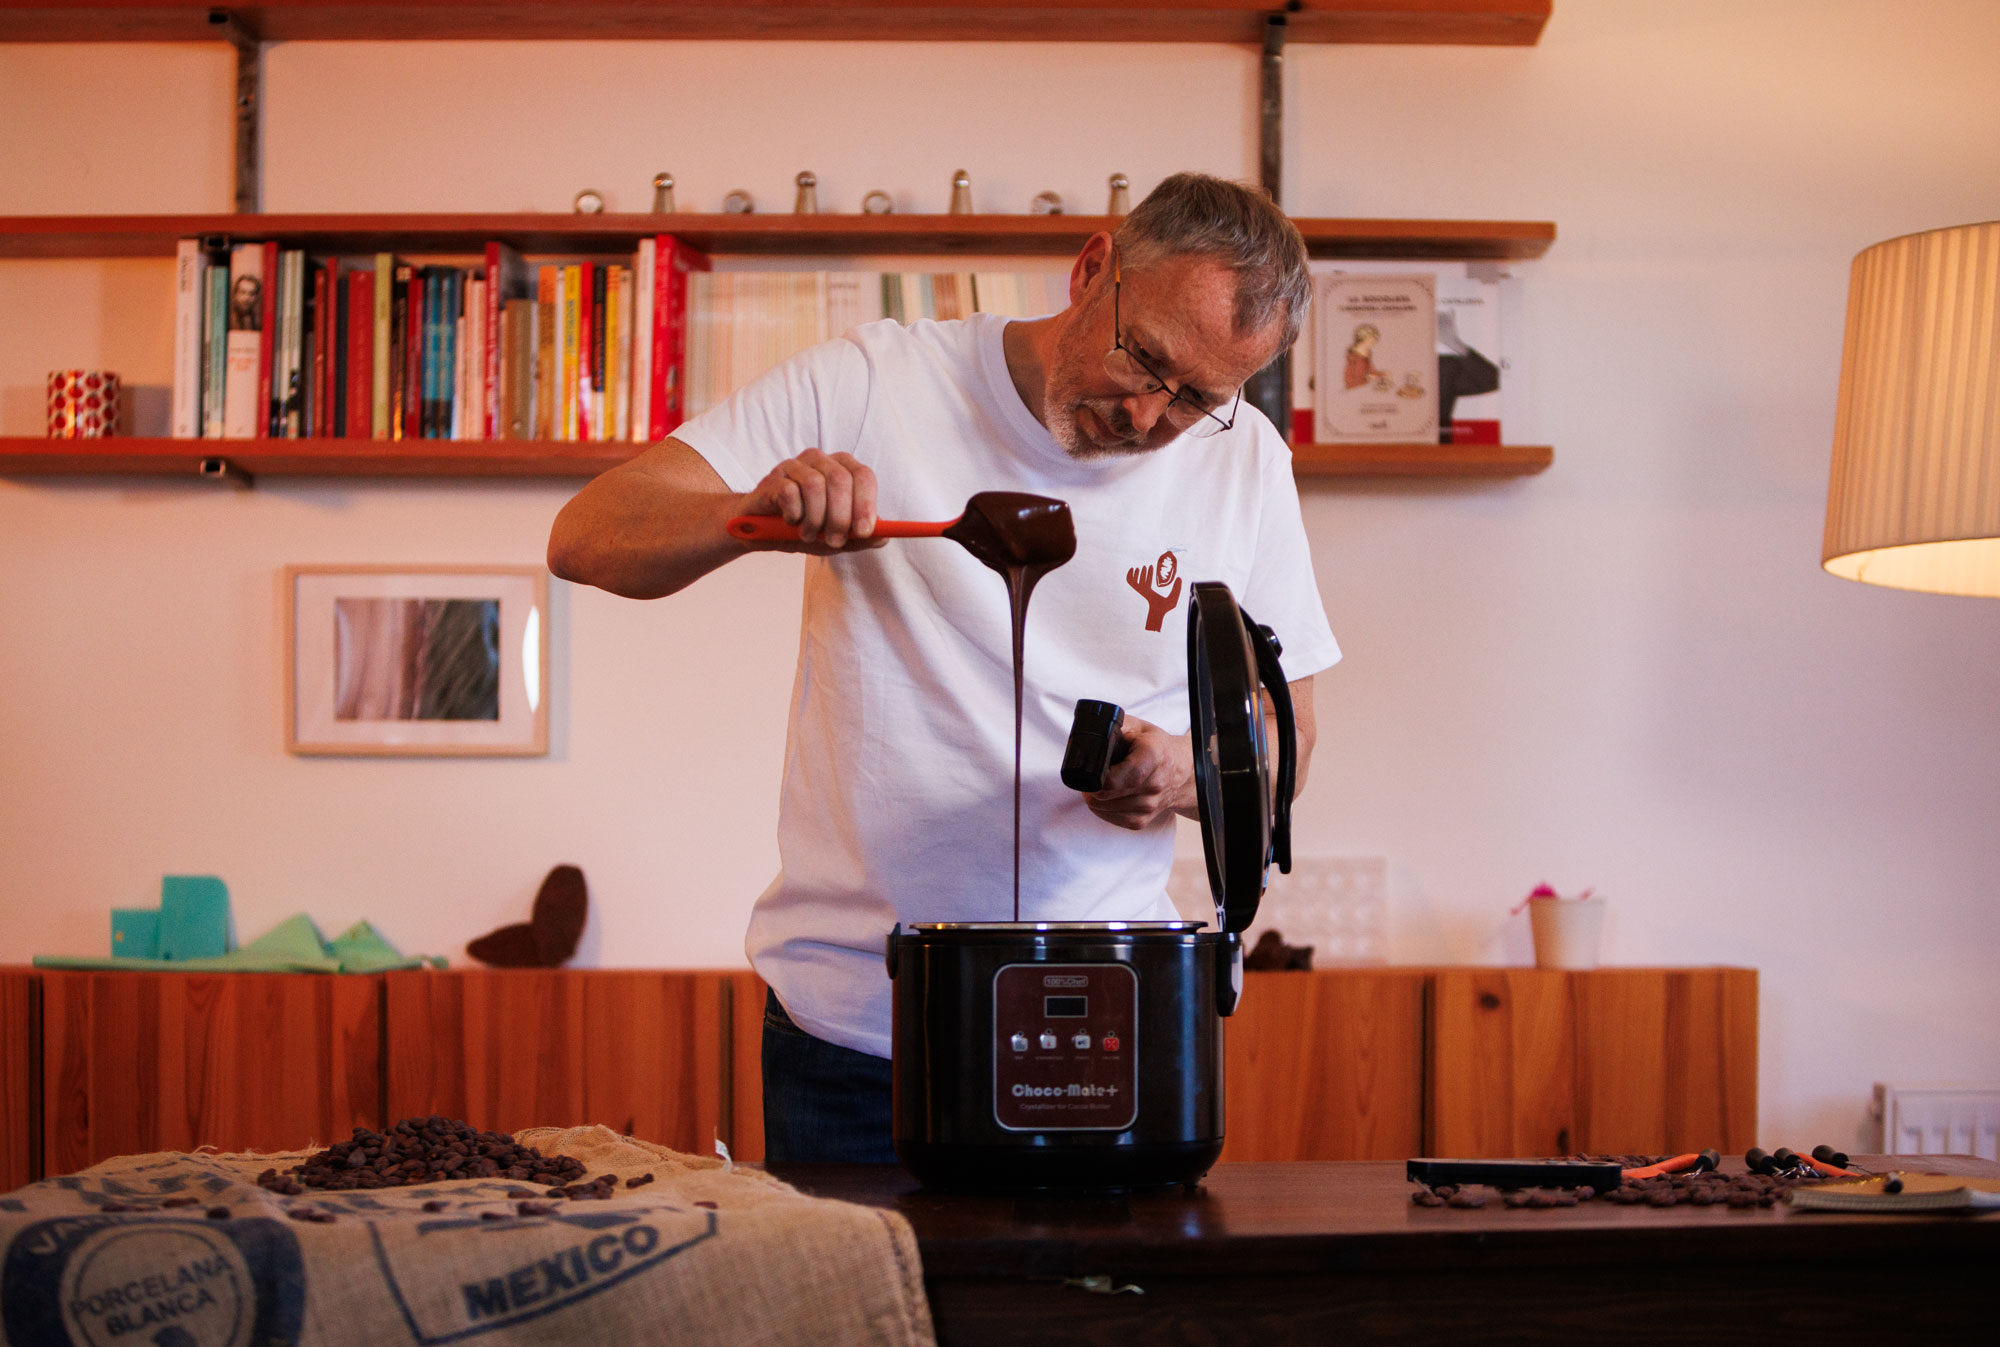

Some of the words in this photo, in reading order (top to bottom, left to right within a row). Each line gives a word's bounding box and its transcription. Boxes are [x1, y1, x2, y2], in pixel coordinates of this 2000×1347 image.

[1012, 1084, 1118, 1097] Choco-Mate+
[69, 1253, 234, 1316] PORCELANA
[461, 1225, 660, 1321] MEXICO
[105, 1288, 217, 1338] BLANCA
